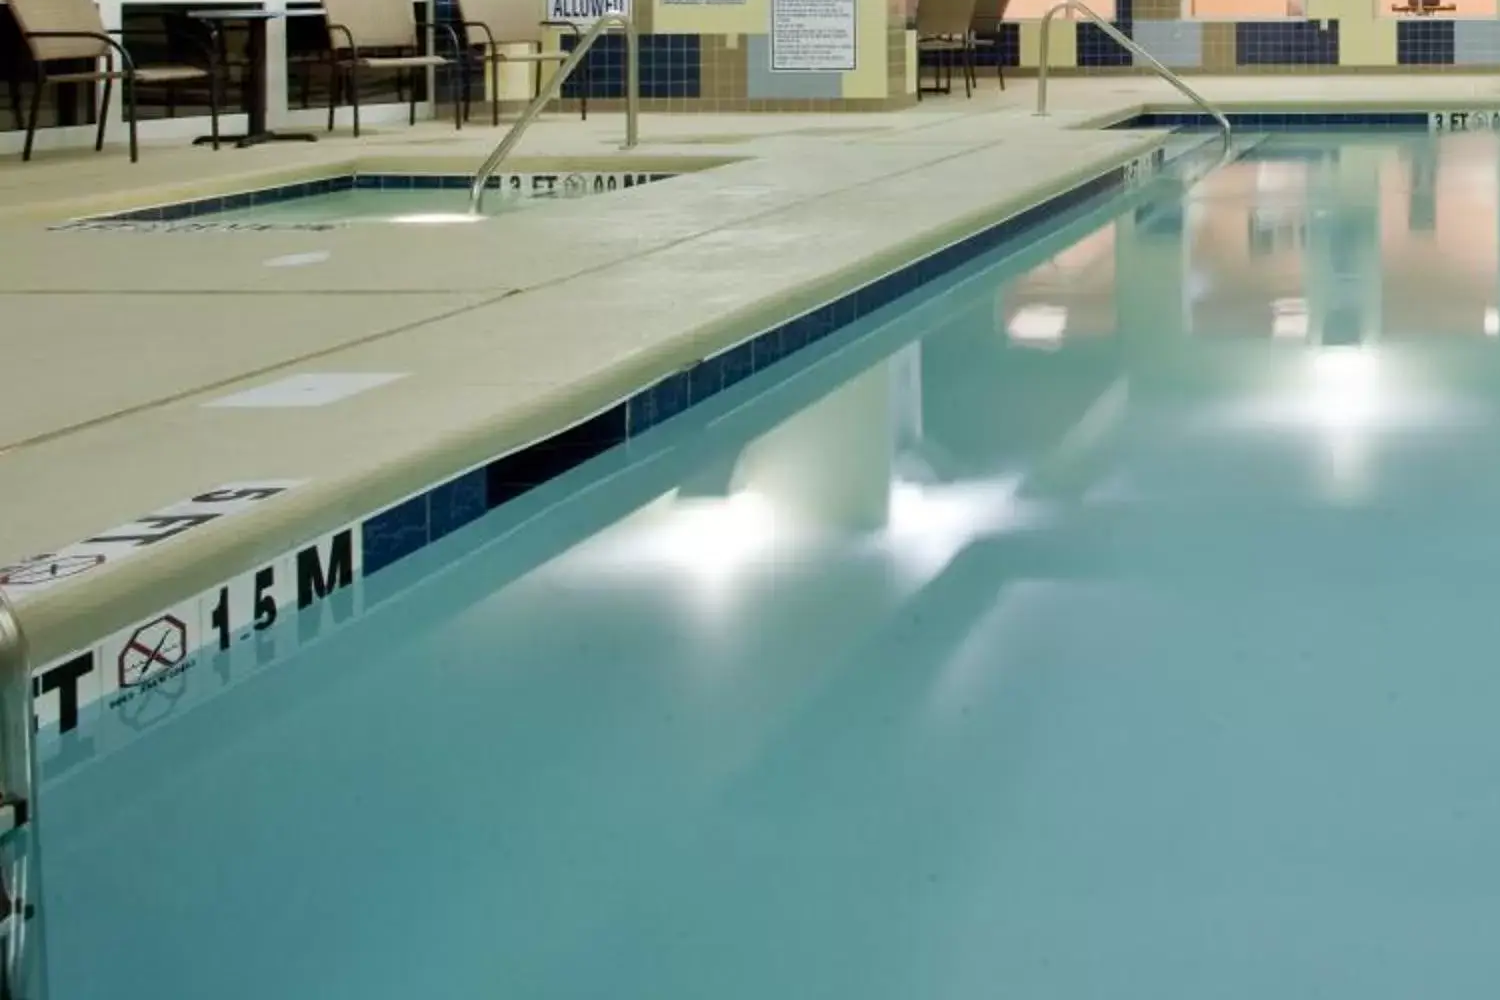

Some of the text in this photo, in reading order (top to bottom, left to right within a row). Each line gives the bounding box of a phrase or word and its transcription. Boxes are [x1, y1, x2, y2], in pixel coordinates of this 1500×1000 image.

[80, 512, 225, 547] FT
[32, 650, 95, 735] T
[297, 528, 354, 611] M
